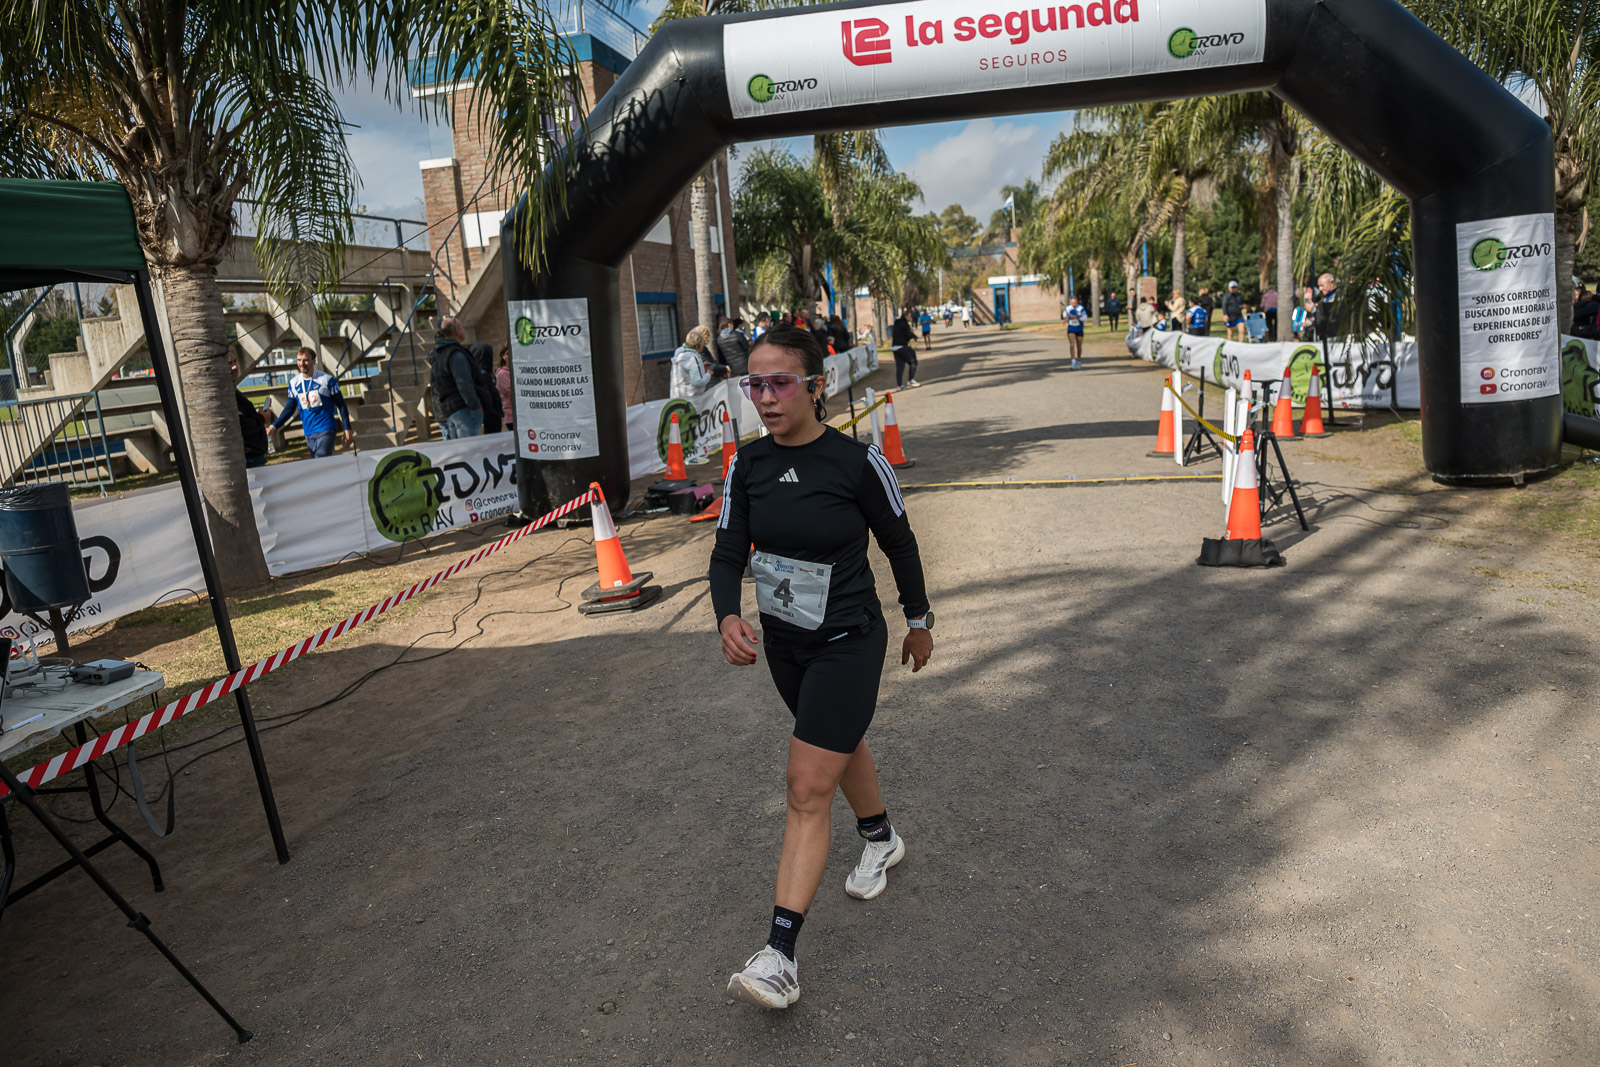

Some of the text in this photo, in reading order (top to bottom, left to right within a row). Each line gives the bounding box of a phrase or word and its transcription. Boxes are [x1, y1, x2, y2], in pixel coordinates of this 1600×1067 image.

[905, 0, 1140, 47] la segunda
[1189, 32, 1245, 49] CRONO
[979, 49, 1068, 70] SEGUROS
[766, 78, 818, 94] CRONO
[1496, 242, 1552, 261] CRONO
[1495, 260, 1519, 271] RAV
[1507, 288, 1550, 302] CORREDORES
[1464, 301, 1555, 319] BUSCANDO MEJORAR LAS
[1473, 315, 1551, 332] EXPERIENCIAS DE LOS
[529, 324, 582, 338] CRONO
[539, 364, 582, 375] CORREDORES
[1500, 365, 1548, 379] Cronorav
[516, 375, 589, 386] BUSCANDO MEJORAR LAS
[1500, 379, 1548, 392] Cronorav
[520, 388, 584, 398] EXPERIENCIAS DE LOS
[539, 430, 581, 440] Cronorav
[540, 443, 582, 452] Cronorav
[419, 506, 455, 534] RAV
[773, 578, 794, 608] 4
